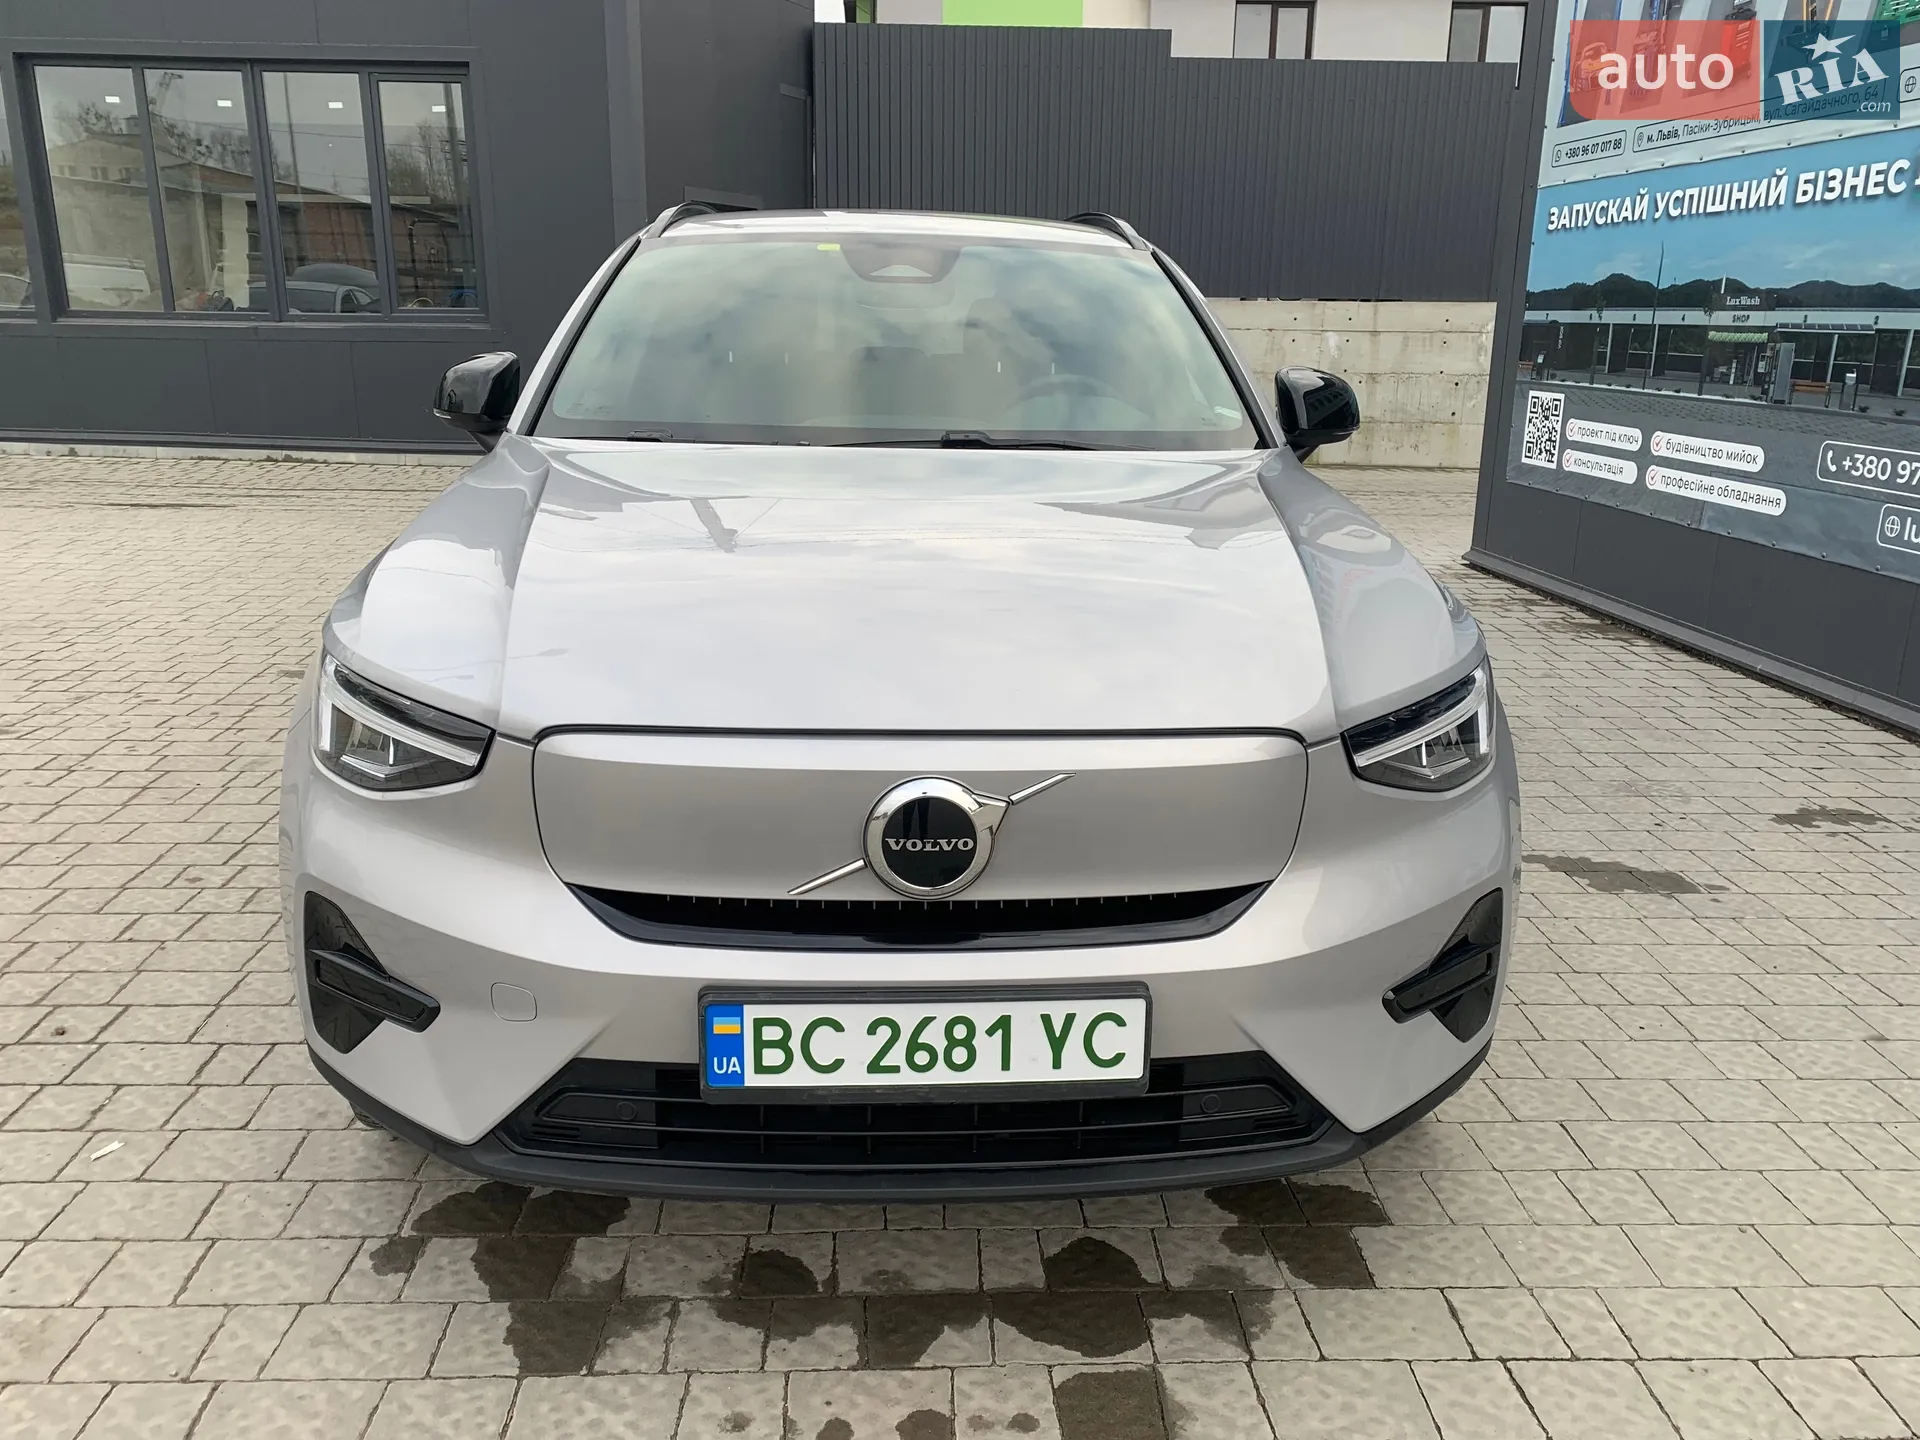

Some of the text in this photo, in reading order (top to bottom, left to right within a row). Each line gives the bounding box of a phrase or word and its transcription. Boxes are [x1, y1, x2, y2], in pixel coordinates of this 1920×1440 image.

[1646, 134, 1655, 143] м.
[1656, 126, 1681, 142] Львів,
[1682, 109, 1761, 137] Пасіки-Зубрицькі,
[1764, 109, 1782, 123] вул.
[1864, 85, 1879, 101] 64
[1565, 146, 1581, 159] +380
[1590, 142, 1600, 154] 07
[1600, 140, 1612, 153] 017
[1613, 138, 1622, 150] 88
[1547, 158, 1911, 231] ЗАПУСКАЙ УСПІШНИЙ БІЗНЕС
[1725, 295, 1761, 306] LuxWash
[1732, 314, 1751, 324] SHOP
[1577, 426, 1639, 445] проект під ключ
[1665, 438, 1759, 465] будівництво мийок
[1573, 457, 1624, 475] консультація
[1842, 453, 1892, 481] +380
[1660, 474, 1782, 508] професійне обладнання
[885, 837, 974, 852] VOLVO
[752, 1012, 1128, 1075] BC 2681 YC
[713, 1056, 742, 1075] UA
